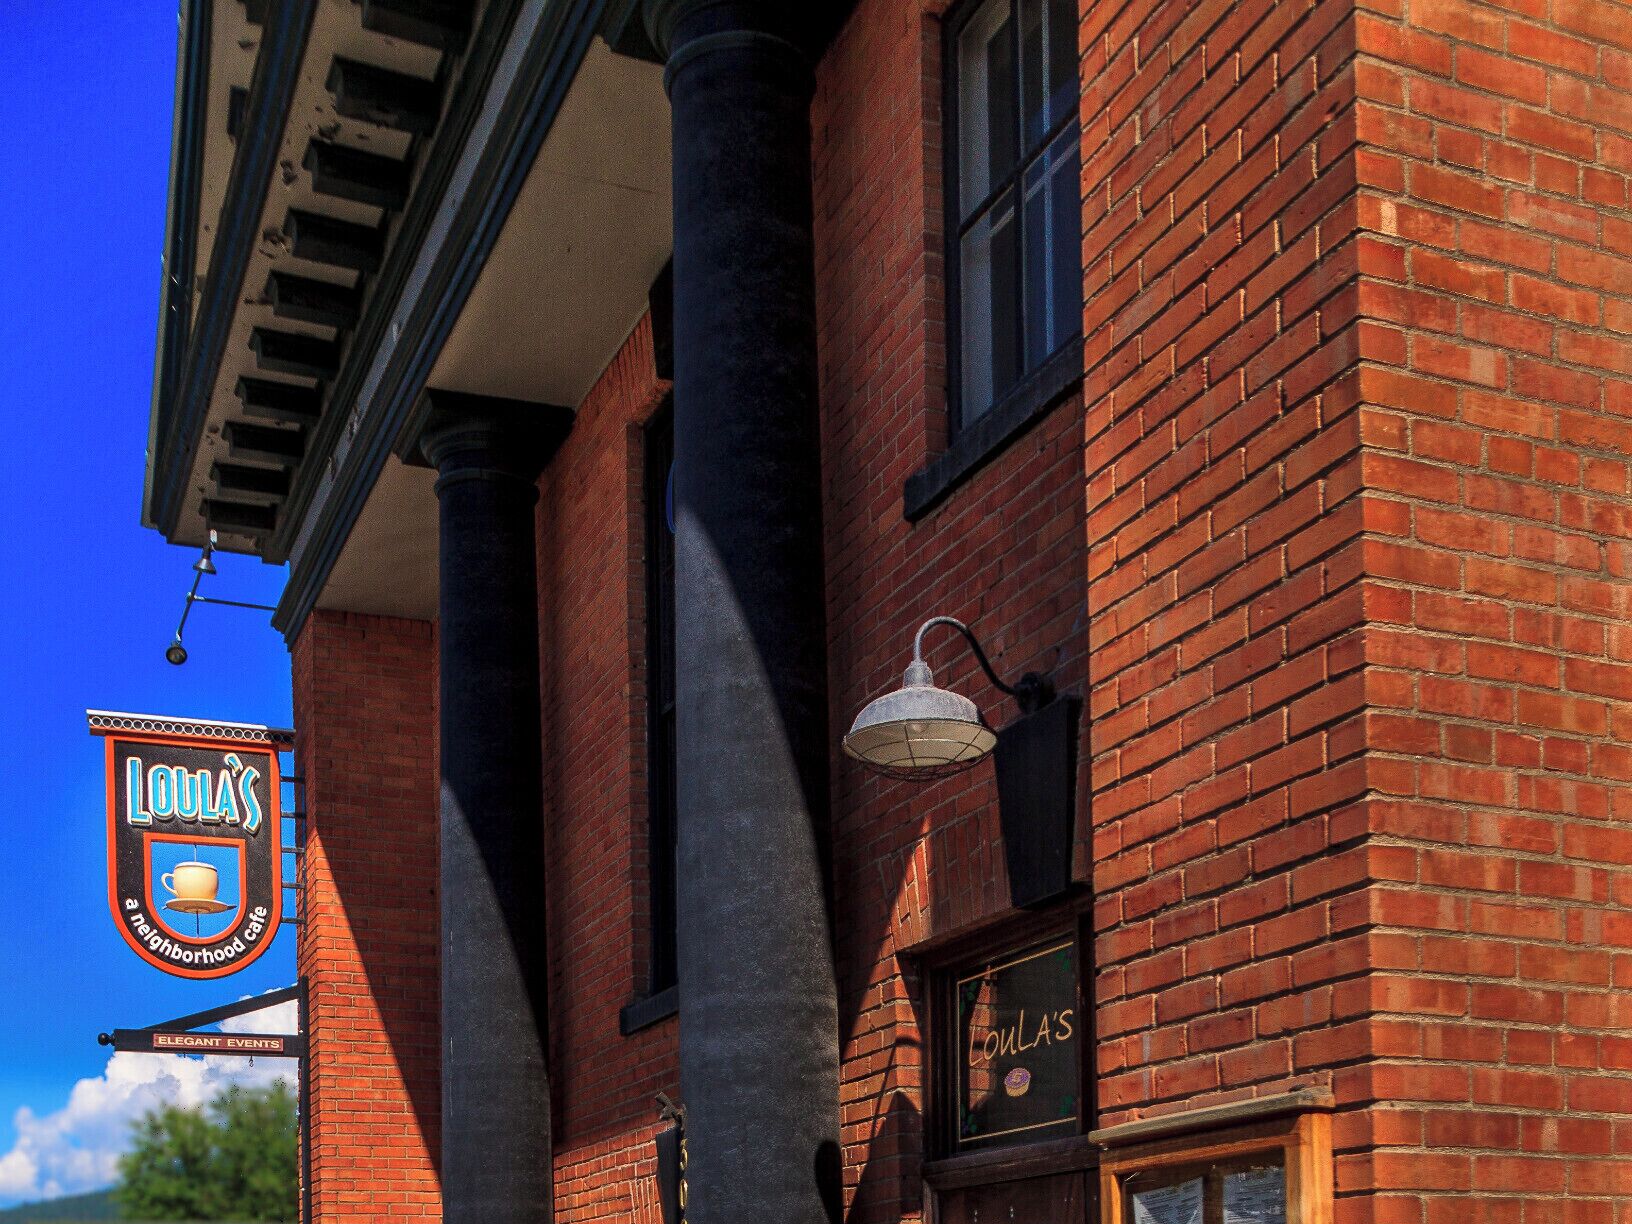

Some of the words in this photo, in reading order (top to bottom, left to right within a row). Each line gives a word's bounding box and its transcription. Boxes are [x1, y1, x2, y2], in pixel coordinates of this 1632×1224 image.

[126, 753, 262, 834] LOULA'S
[126, 898, 139, 910] a
[131, 913, 246, 963] neighborhood
[244, 906, 267, 941] cafe
[158, 1036, 222, 1047] ELEGANT
[227, 1038, 280, 1049] EVENTS
